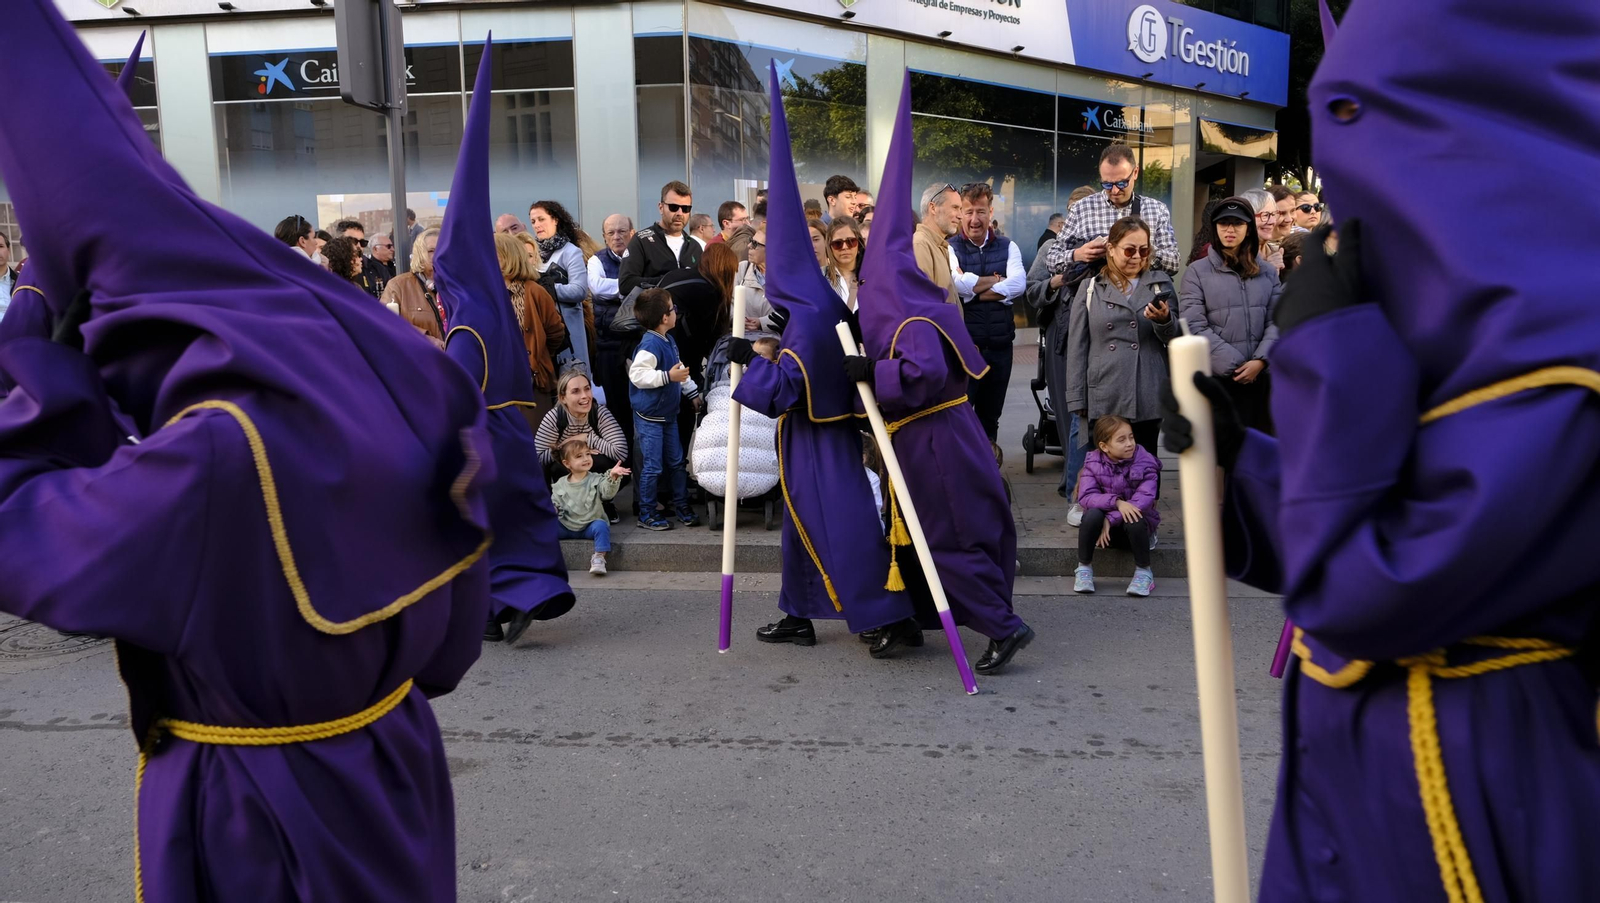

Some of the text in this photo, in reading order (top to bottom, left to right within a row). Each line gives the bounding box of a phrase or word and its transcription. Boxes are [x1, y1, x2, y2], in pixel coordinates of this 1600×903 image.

[938, 0, 949, 10] de
[949, 1, 982, 17] Empresas
[983, 10, 988, 20] y
[988, 9, 1020, 25] Proyectos
[1167, 16, 1249, 76] TGestión
[1103, 109, 1154, 133] CaixaBank
